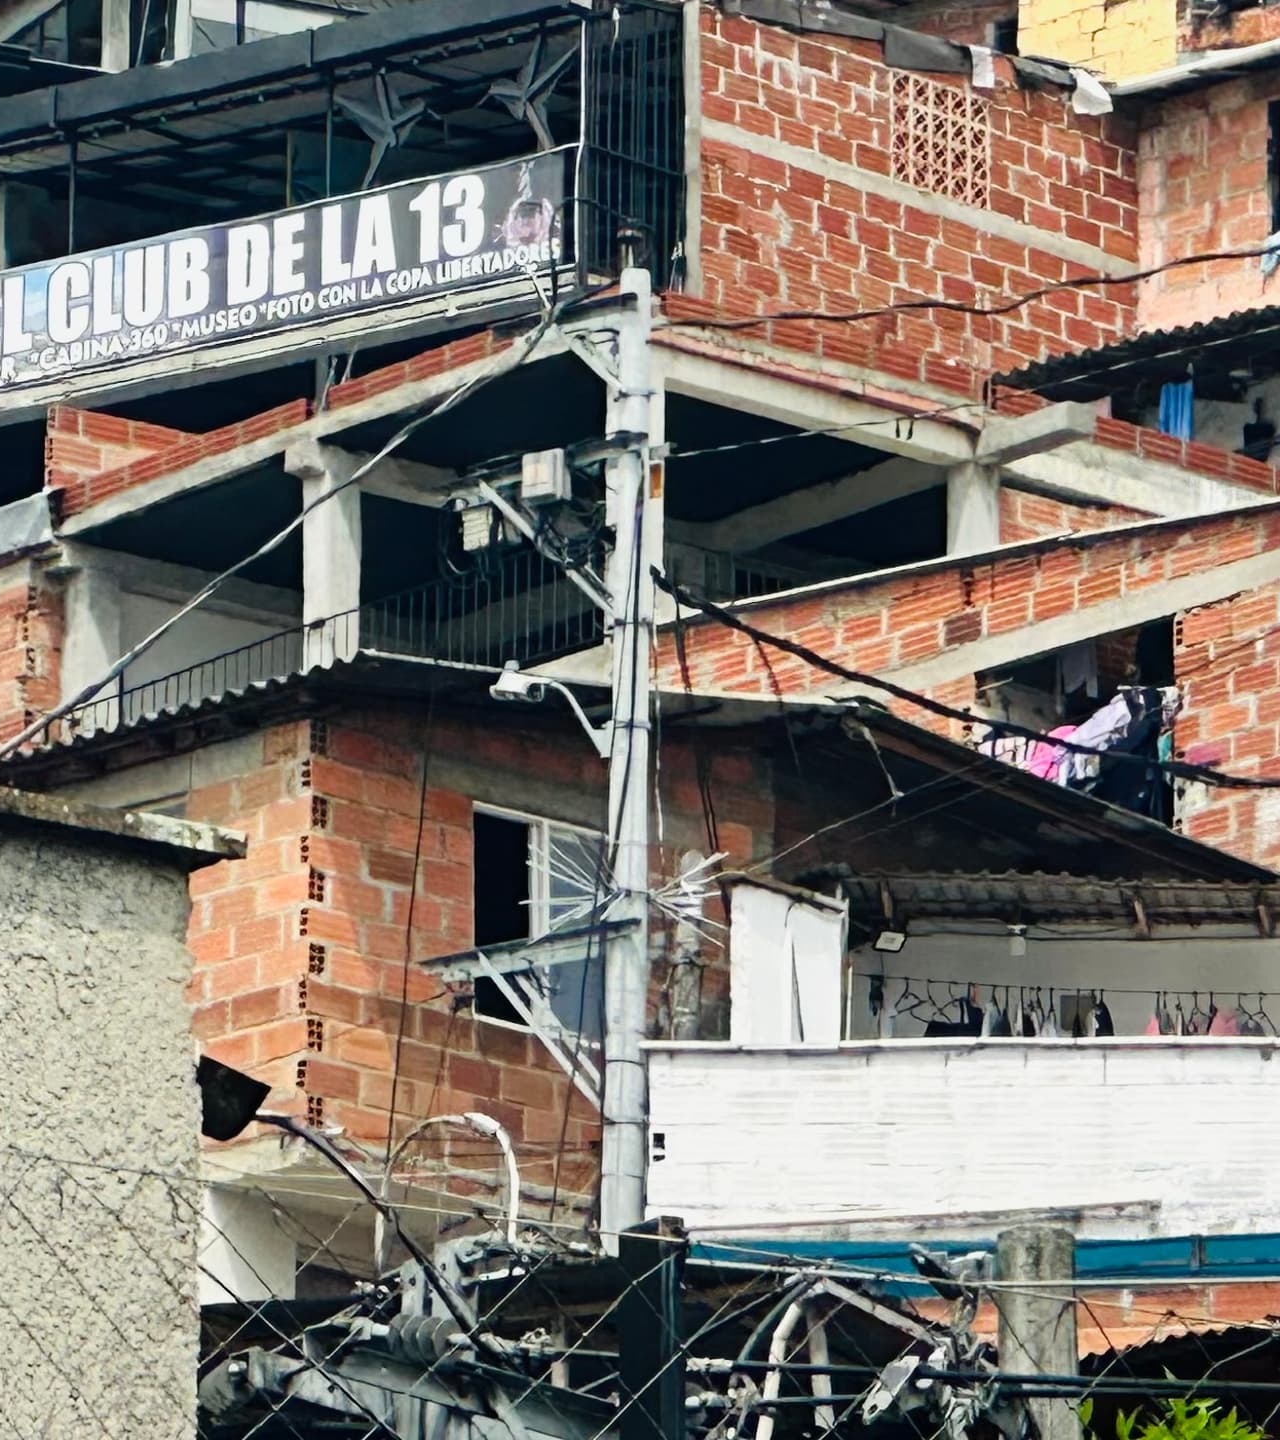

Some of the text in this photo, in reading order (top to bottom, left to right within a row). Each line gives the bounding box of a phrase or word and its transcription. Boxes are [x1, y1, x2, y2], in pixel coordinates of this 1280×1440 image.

[46, 237, 210, 346] CLUB
[226, 215, 305, 306] DE
[321, 195, 396, 284] LA
[409, 174, 485, 263] 13
[318, 284, 357, 309] CON
[361, 278, 384, 300] LA
[386, 268, 433, 294] COPA
